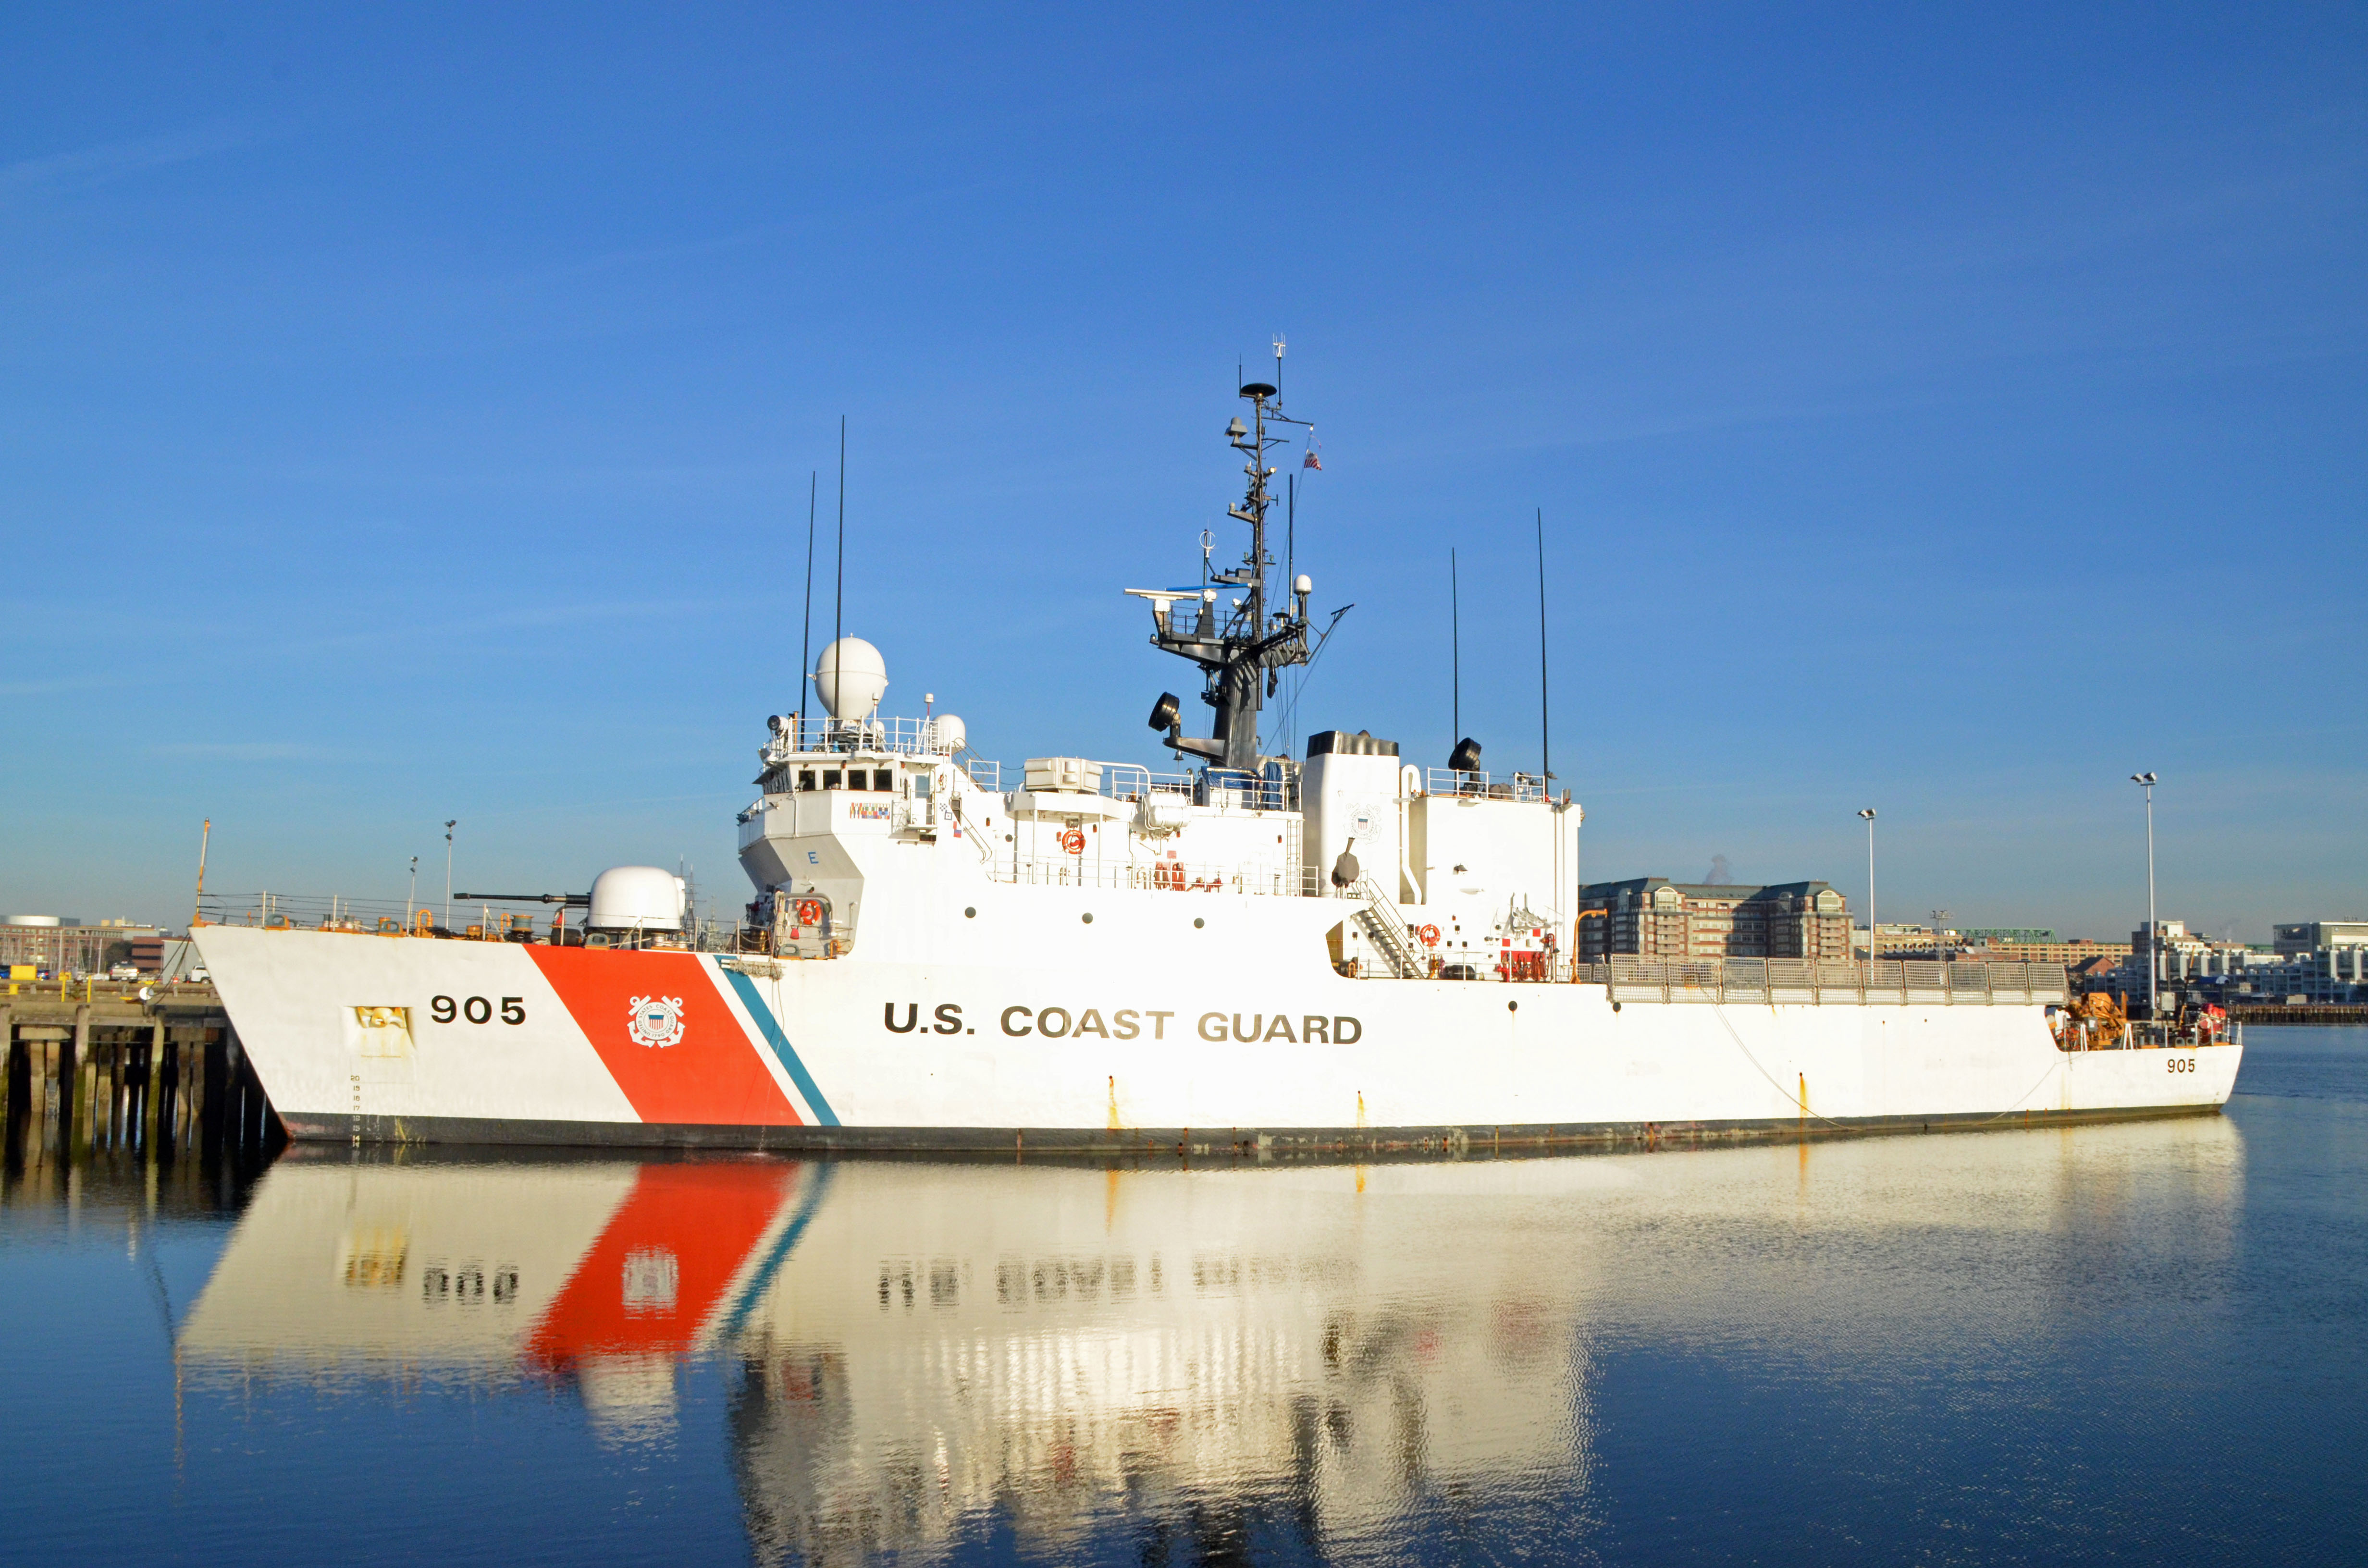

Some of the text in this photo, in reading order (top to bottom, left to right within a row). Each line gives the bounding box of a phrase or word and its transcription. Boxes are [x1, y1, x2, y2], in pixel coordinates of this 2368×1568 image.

[808, 851, 819, 864] E
[431, 995, 526, 1025] 905
[638, 1004, 674, 1036] UNITED STATES COAST GUARD
[884, 1002, 1362, 1044] U.S. COAST GUARD
[2168, 1058, 2195, 1073] 905
